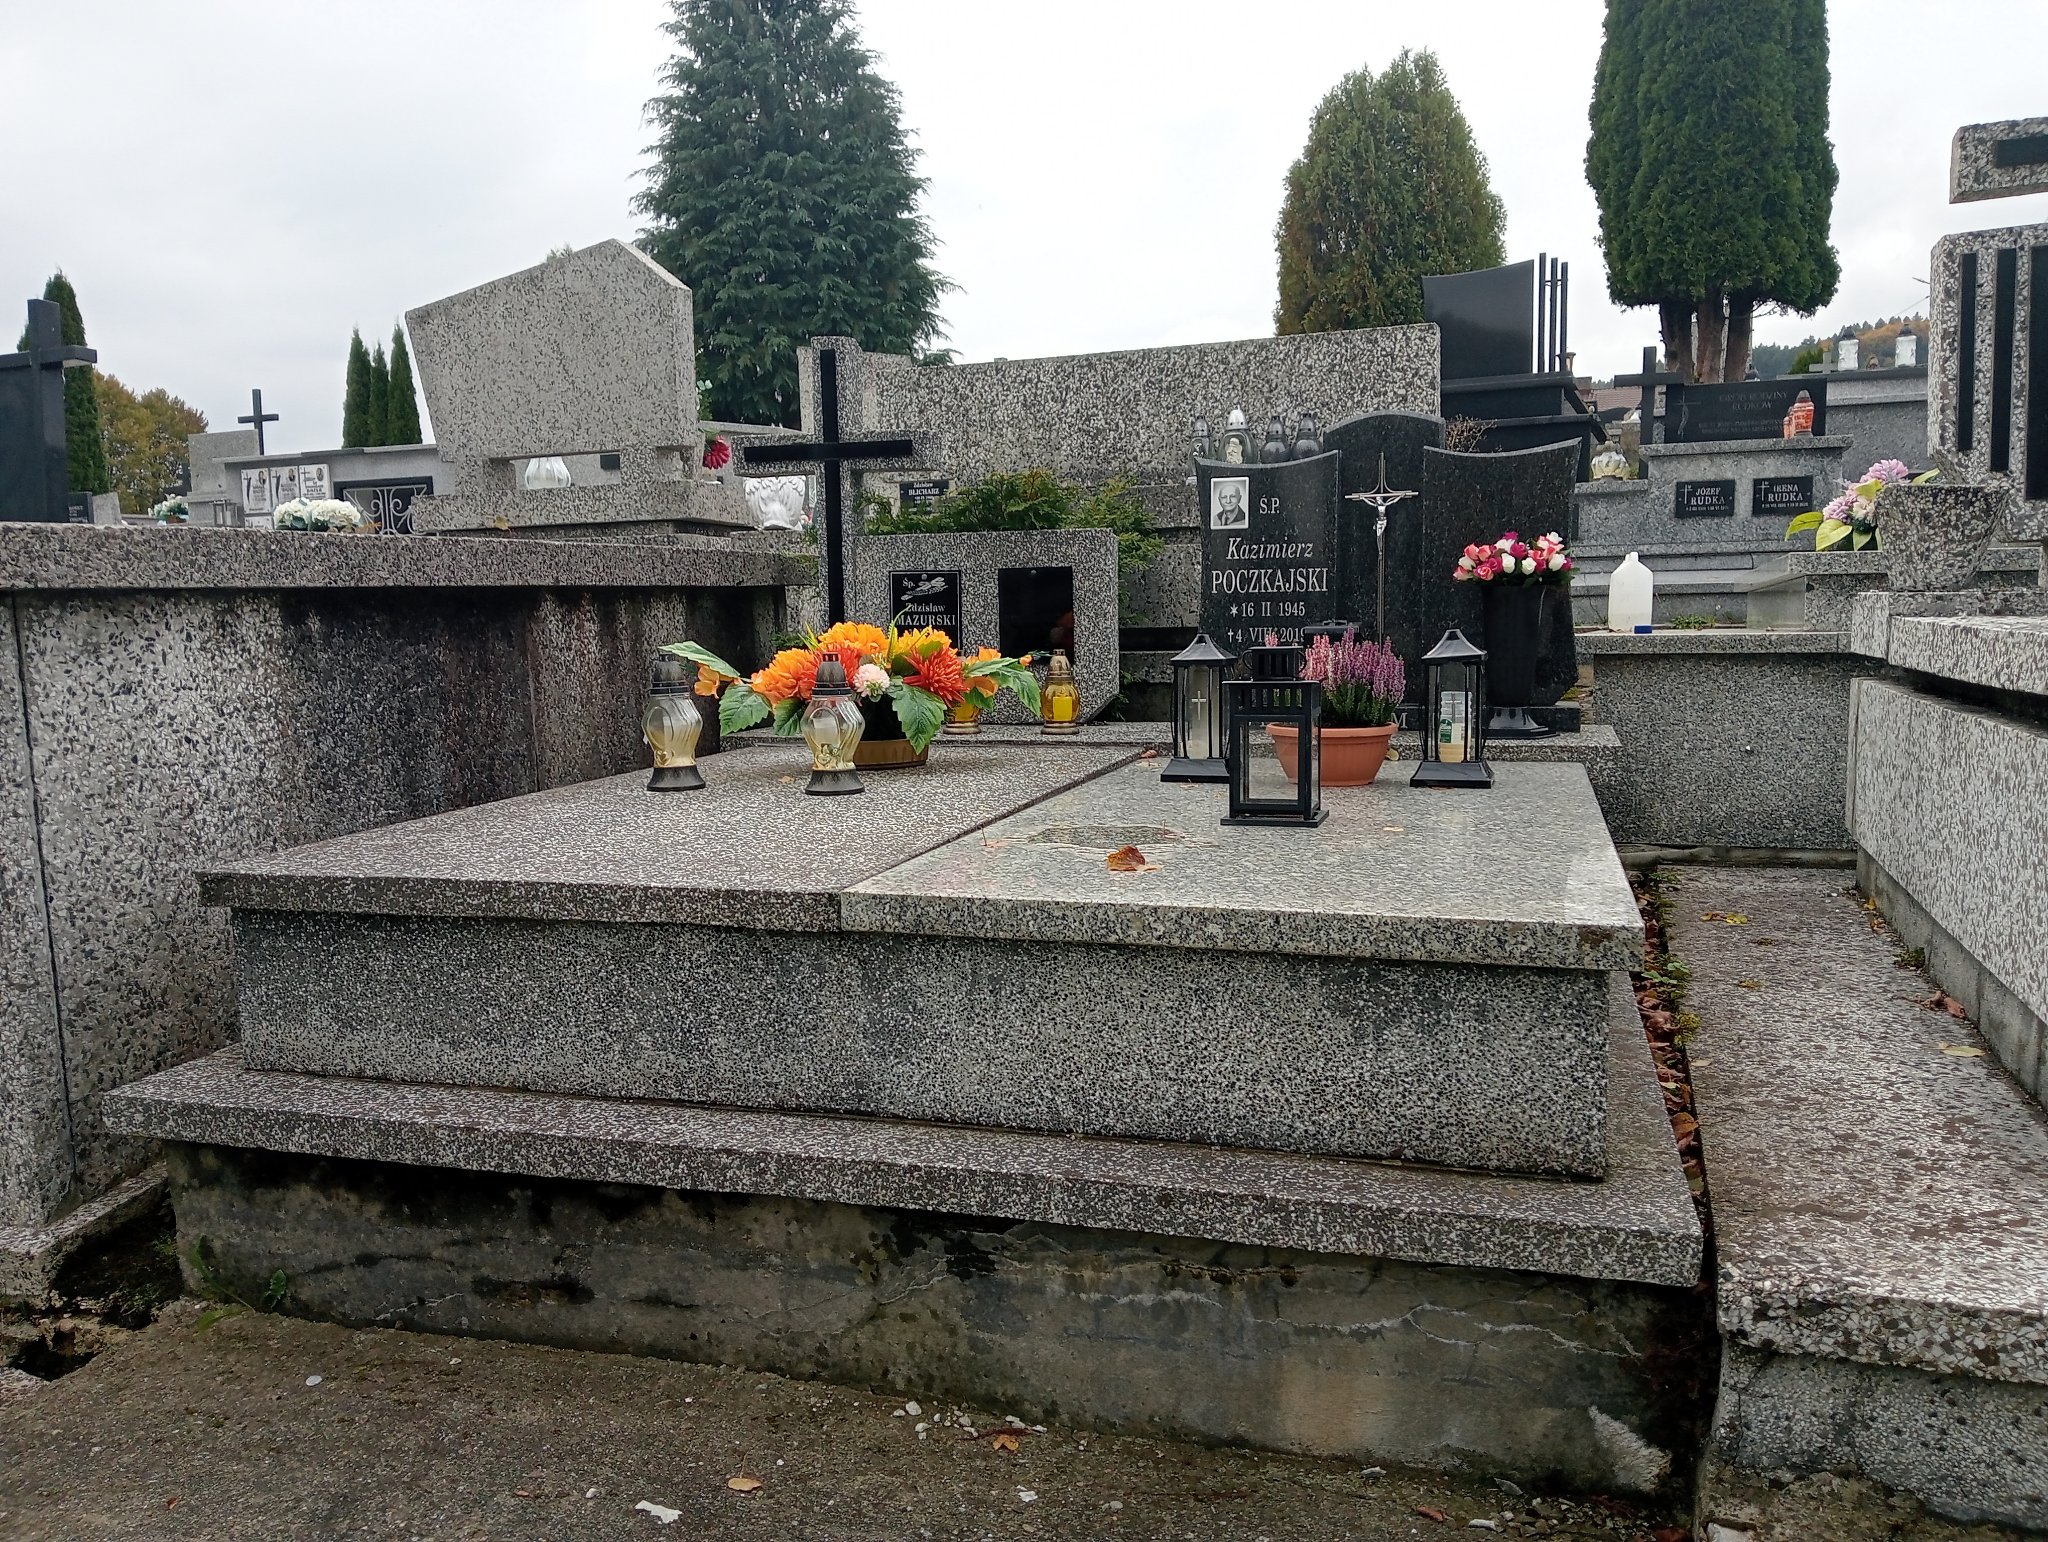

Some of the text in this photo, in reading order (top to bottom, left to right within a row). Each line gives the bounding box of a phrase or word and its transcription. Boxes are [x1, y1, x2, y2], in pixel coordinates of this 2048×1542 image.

[1695, 486, 1721, 496] JÓZEF
[1773, 484, 1799, 492] IRENA
[1691, 496, 1725, 505] RUDKA
[1768, 492, 1803, 503] RUDKA
[1226, 536, 1313, 560] Kazimierz
[1211, 568, 1328, 594] POCZKAJSKI
[1261, 602, 1271, 617] II
[1278, 602, 1306, 617] 1945
[896, 614, 956, 626] MAZURSKI
